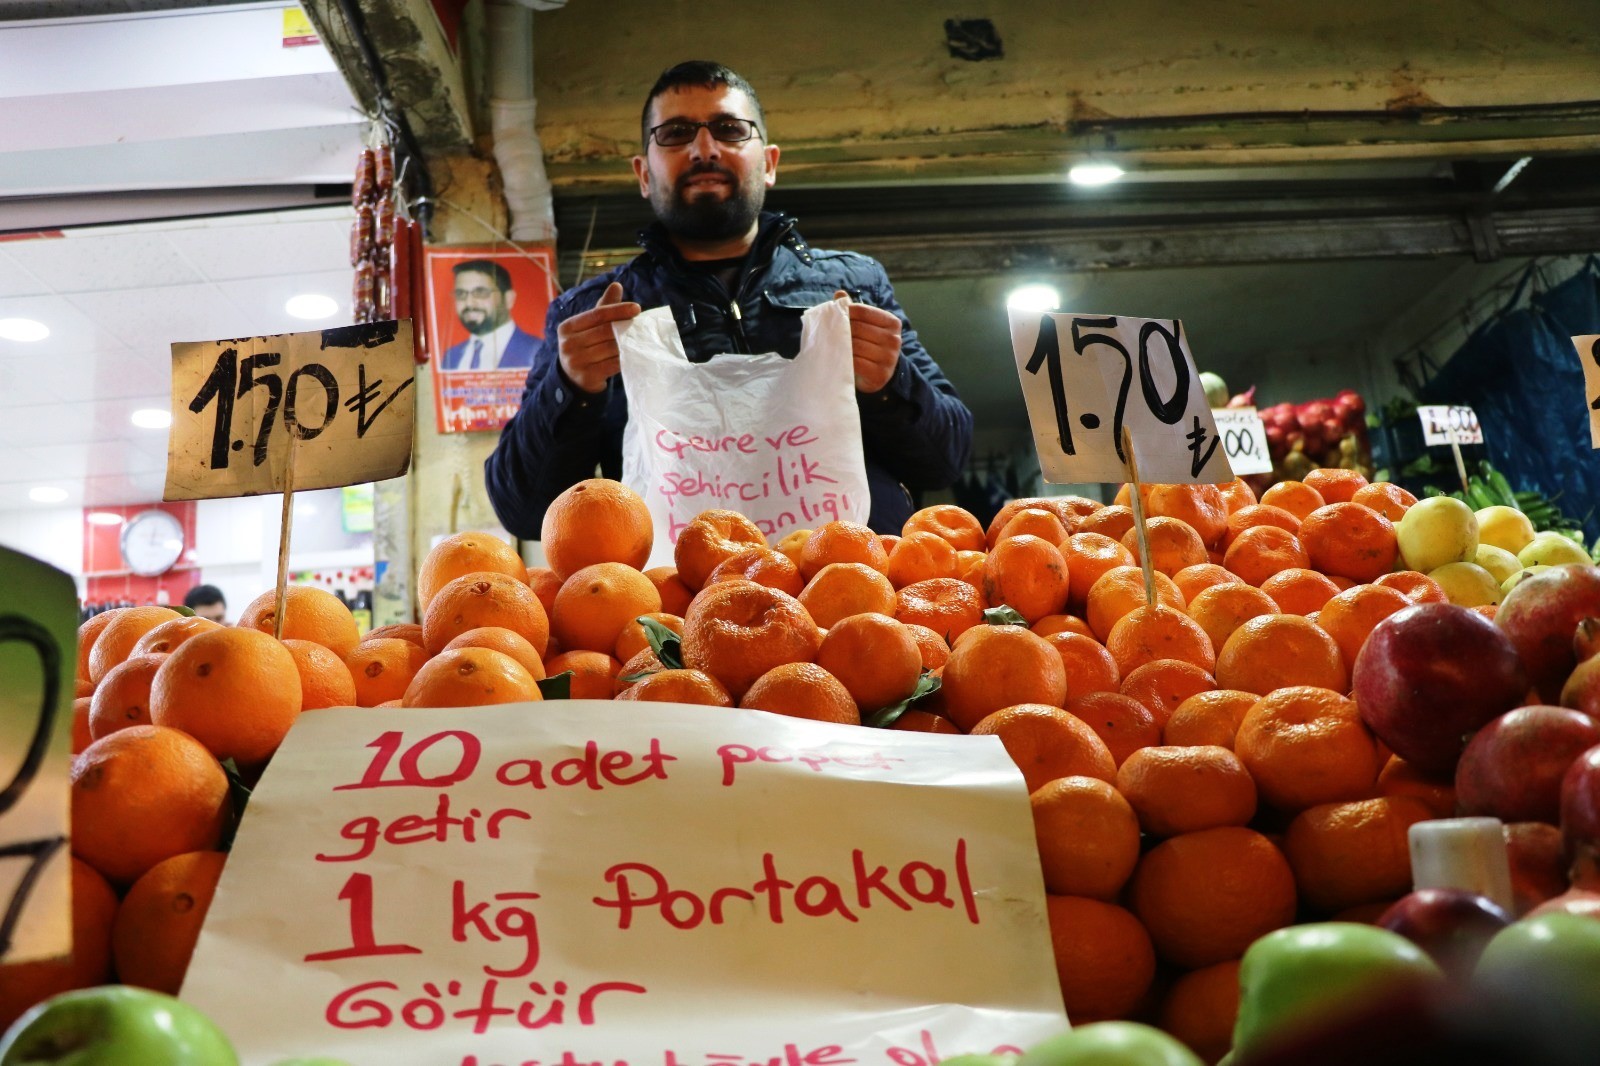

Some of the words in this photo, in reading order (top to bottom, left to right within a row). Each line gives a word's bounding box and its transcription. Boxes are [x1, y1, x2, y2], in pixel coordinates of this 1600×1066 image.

[655, 428, 758, 460] Çevre
[765, 424, 819, 448] ve
[332, 730, 482, 792] 10
[496, 737, 679, 791] adet
[315, 793, 532, 863] getir
[303, 871, 423, 962] 1
[592, 837, 980, 930] Portakal
[324, 978, 648, 1034] Götür
